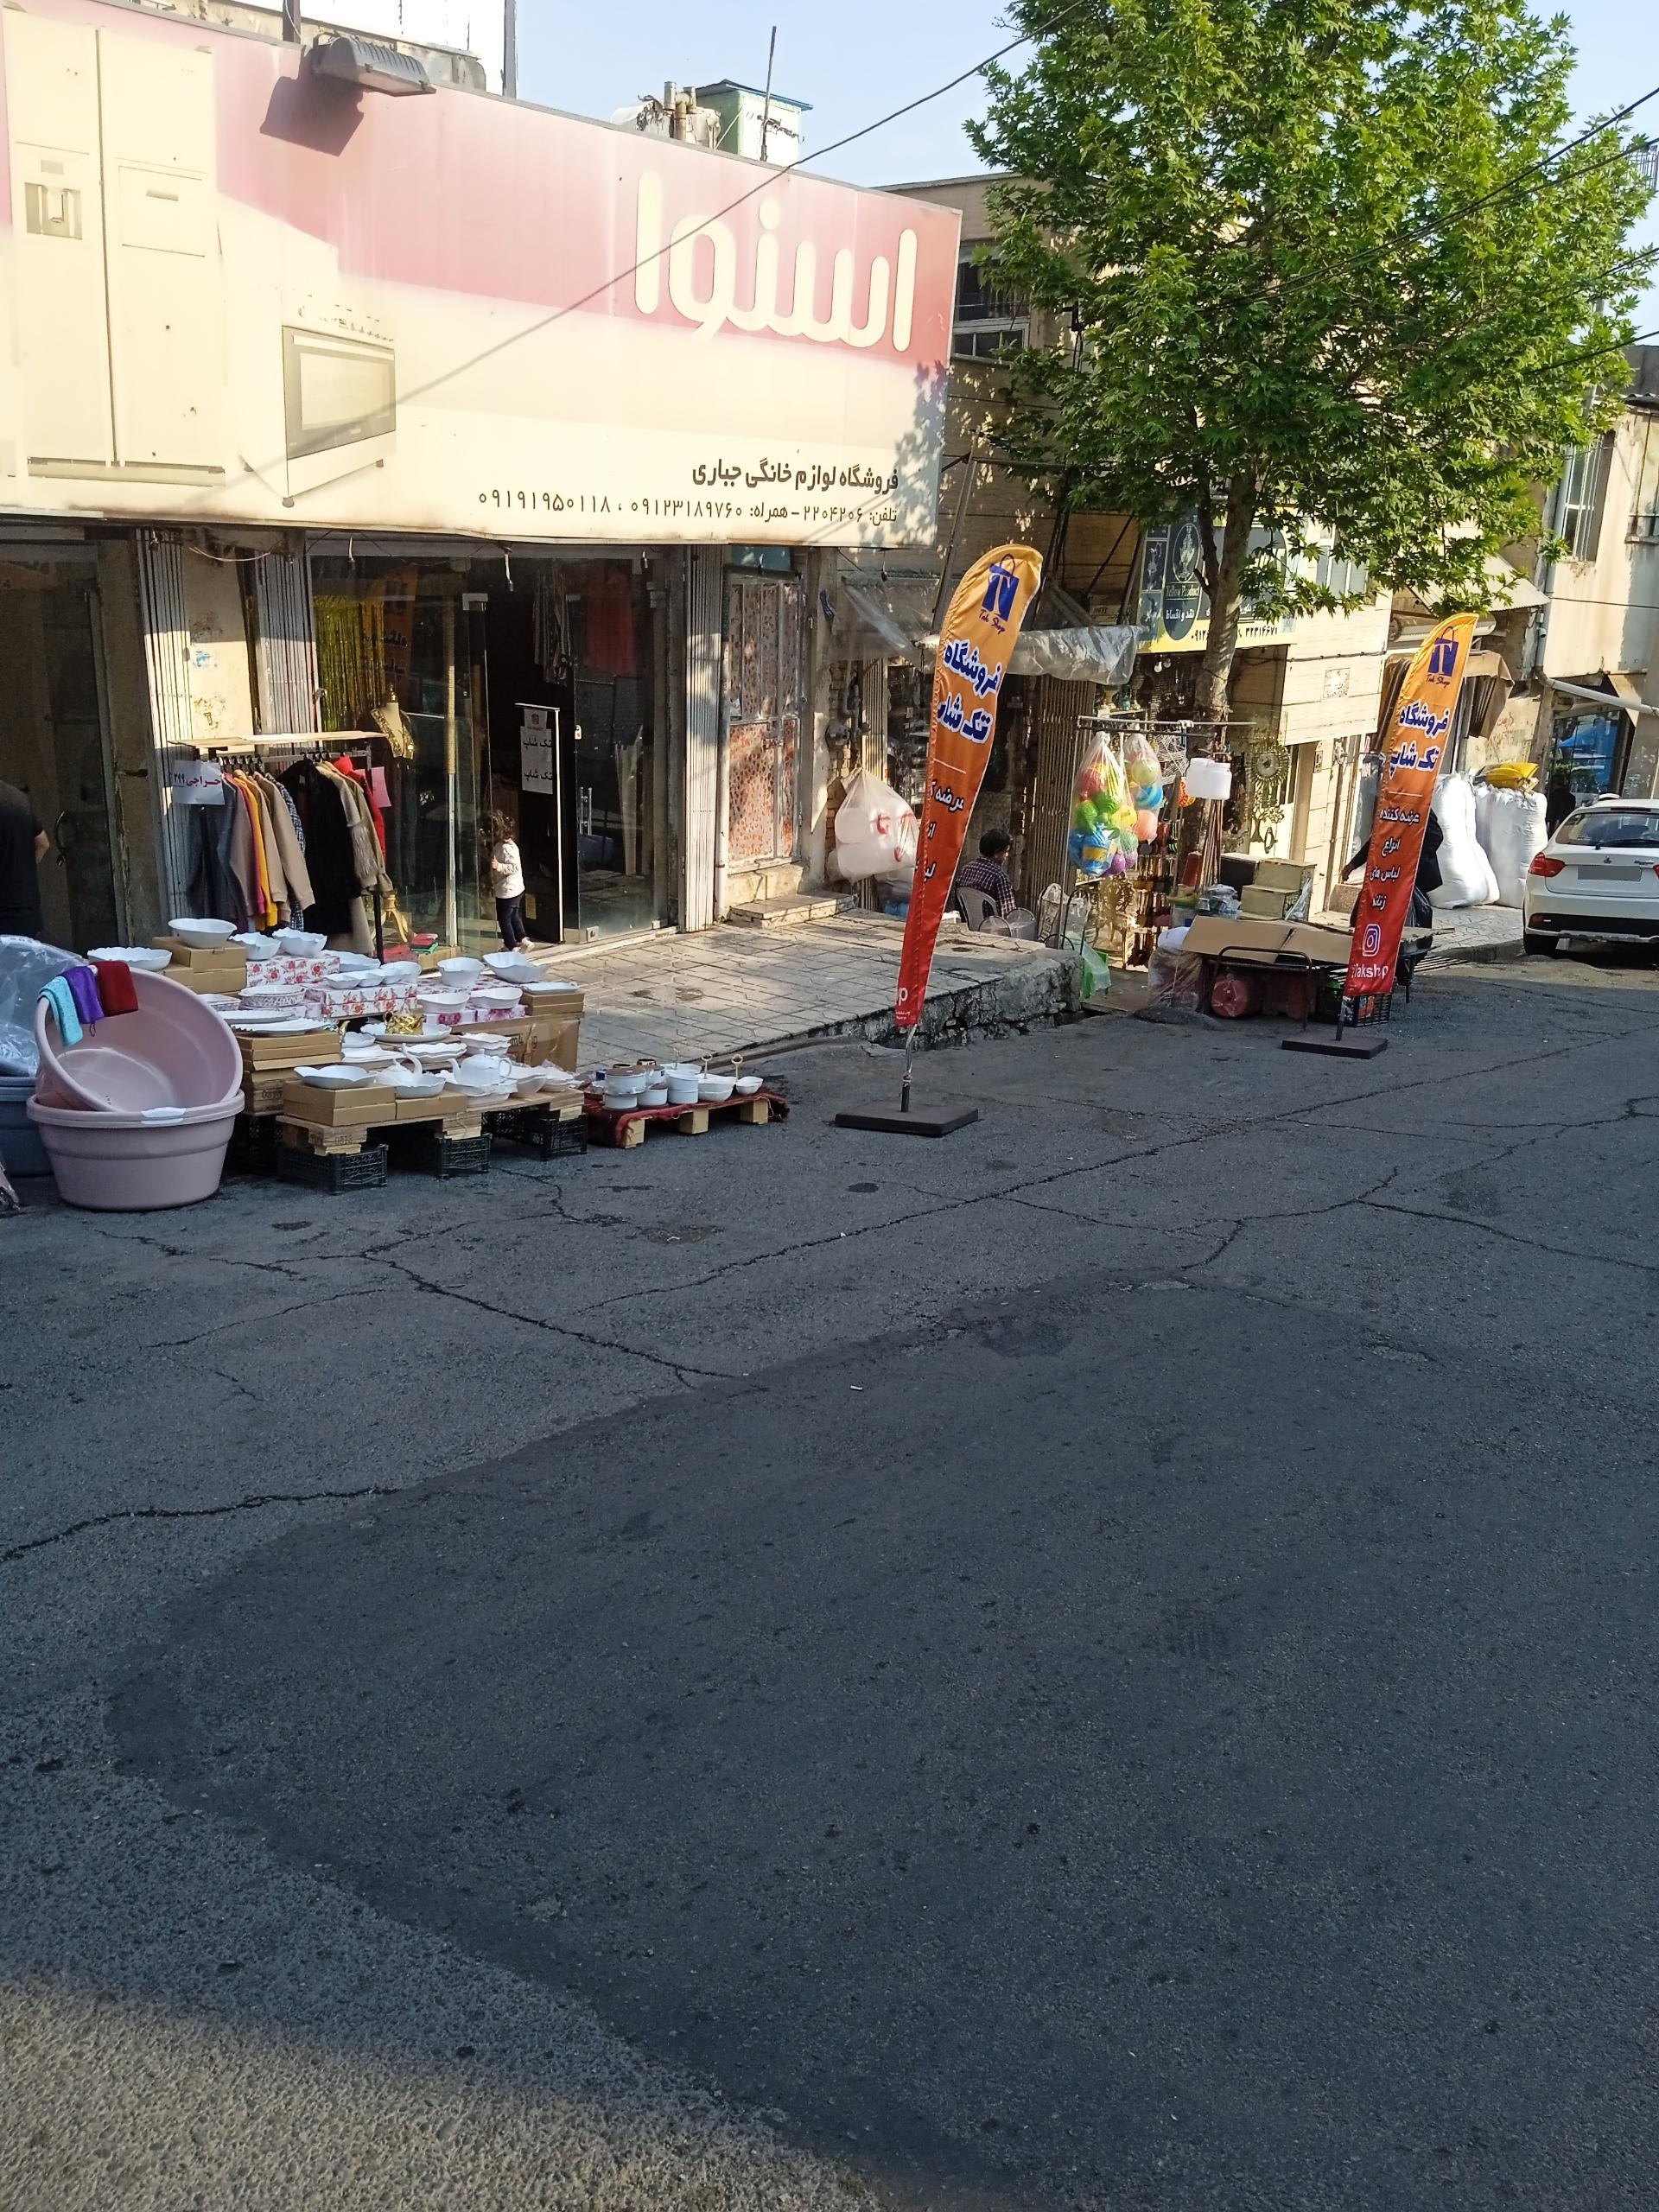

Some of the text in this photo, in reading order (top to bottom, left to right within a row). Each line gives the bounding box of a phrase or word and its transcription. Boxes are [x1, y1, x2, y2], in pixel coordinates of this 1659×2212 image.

[633, 170, 918, 353] اسنوا
[692, 458, 899, 494] فروشگاه لوازم خانگی جباری
[479, 489, 611, 513] ۰۹۱۹۱۹۵۰۱۱۸
[632, 499, 742, 518] ۰۹۱۲۳۱۸۹۷۶۰
[804, 505, 863, 522] ۲۲۰۴۲۰۶
[869, 507, 897, 526] تلفن:
[944, 641, 1001, 697] فروشگاه
[961, 709, 992, 741] تک
[1399, 701, 1449, 737] فروشگاه
[523, 737, 537, 750] شاپ
[1389, 743, 1440, 777] تک شاپ
[186, 775, 221, 788] حراجی
[524, 769, 538, 782] شاپ
[1380, 809, 1420, 825] عرضه کننده
[1382, 837, 1401, 857] انواع
[1381, 867, 1401, 882] لباس
